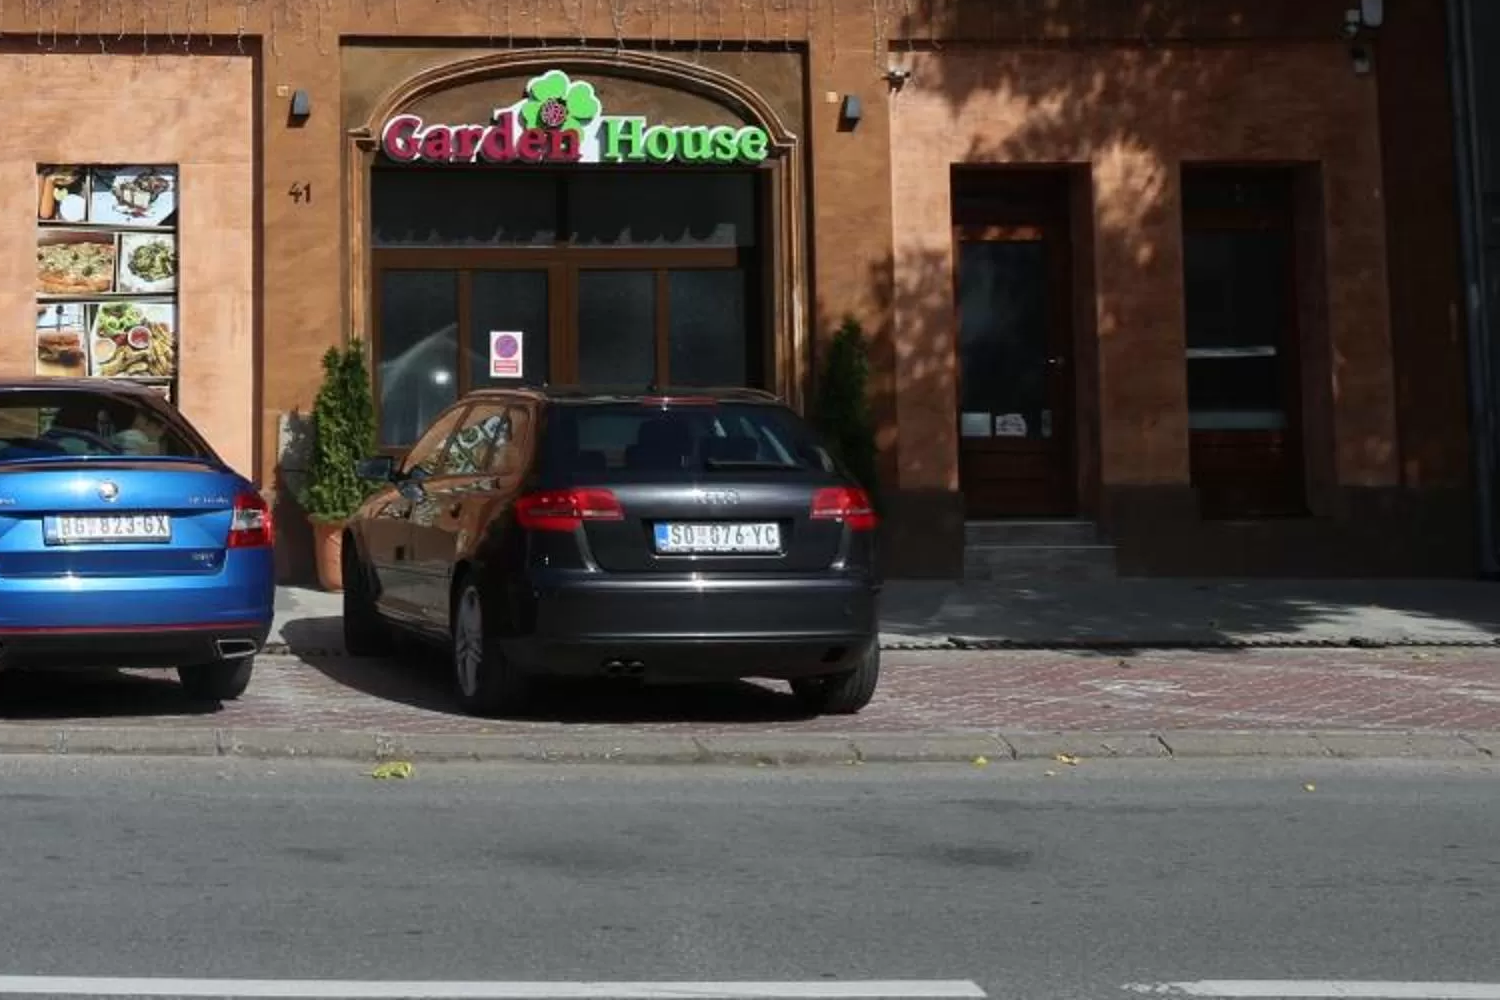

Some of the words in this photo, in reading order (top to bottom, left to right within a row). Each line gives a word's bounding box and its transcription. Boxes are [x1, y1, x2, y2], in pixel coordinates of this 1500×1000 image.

[384, 110, 583, 163] Garden
[602, 115, 770, 163] House
[287, 181, 311, 204] 41
[671, 523, 695, 545] SO
